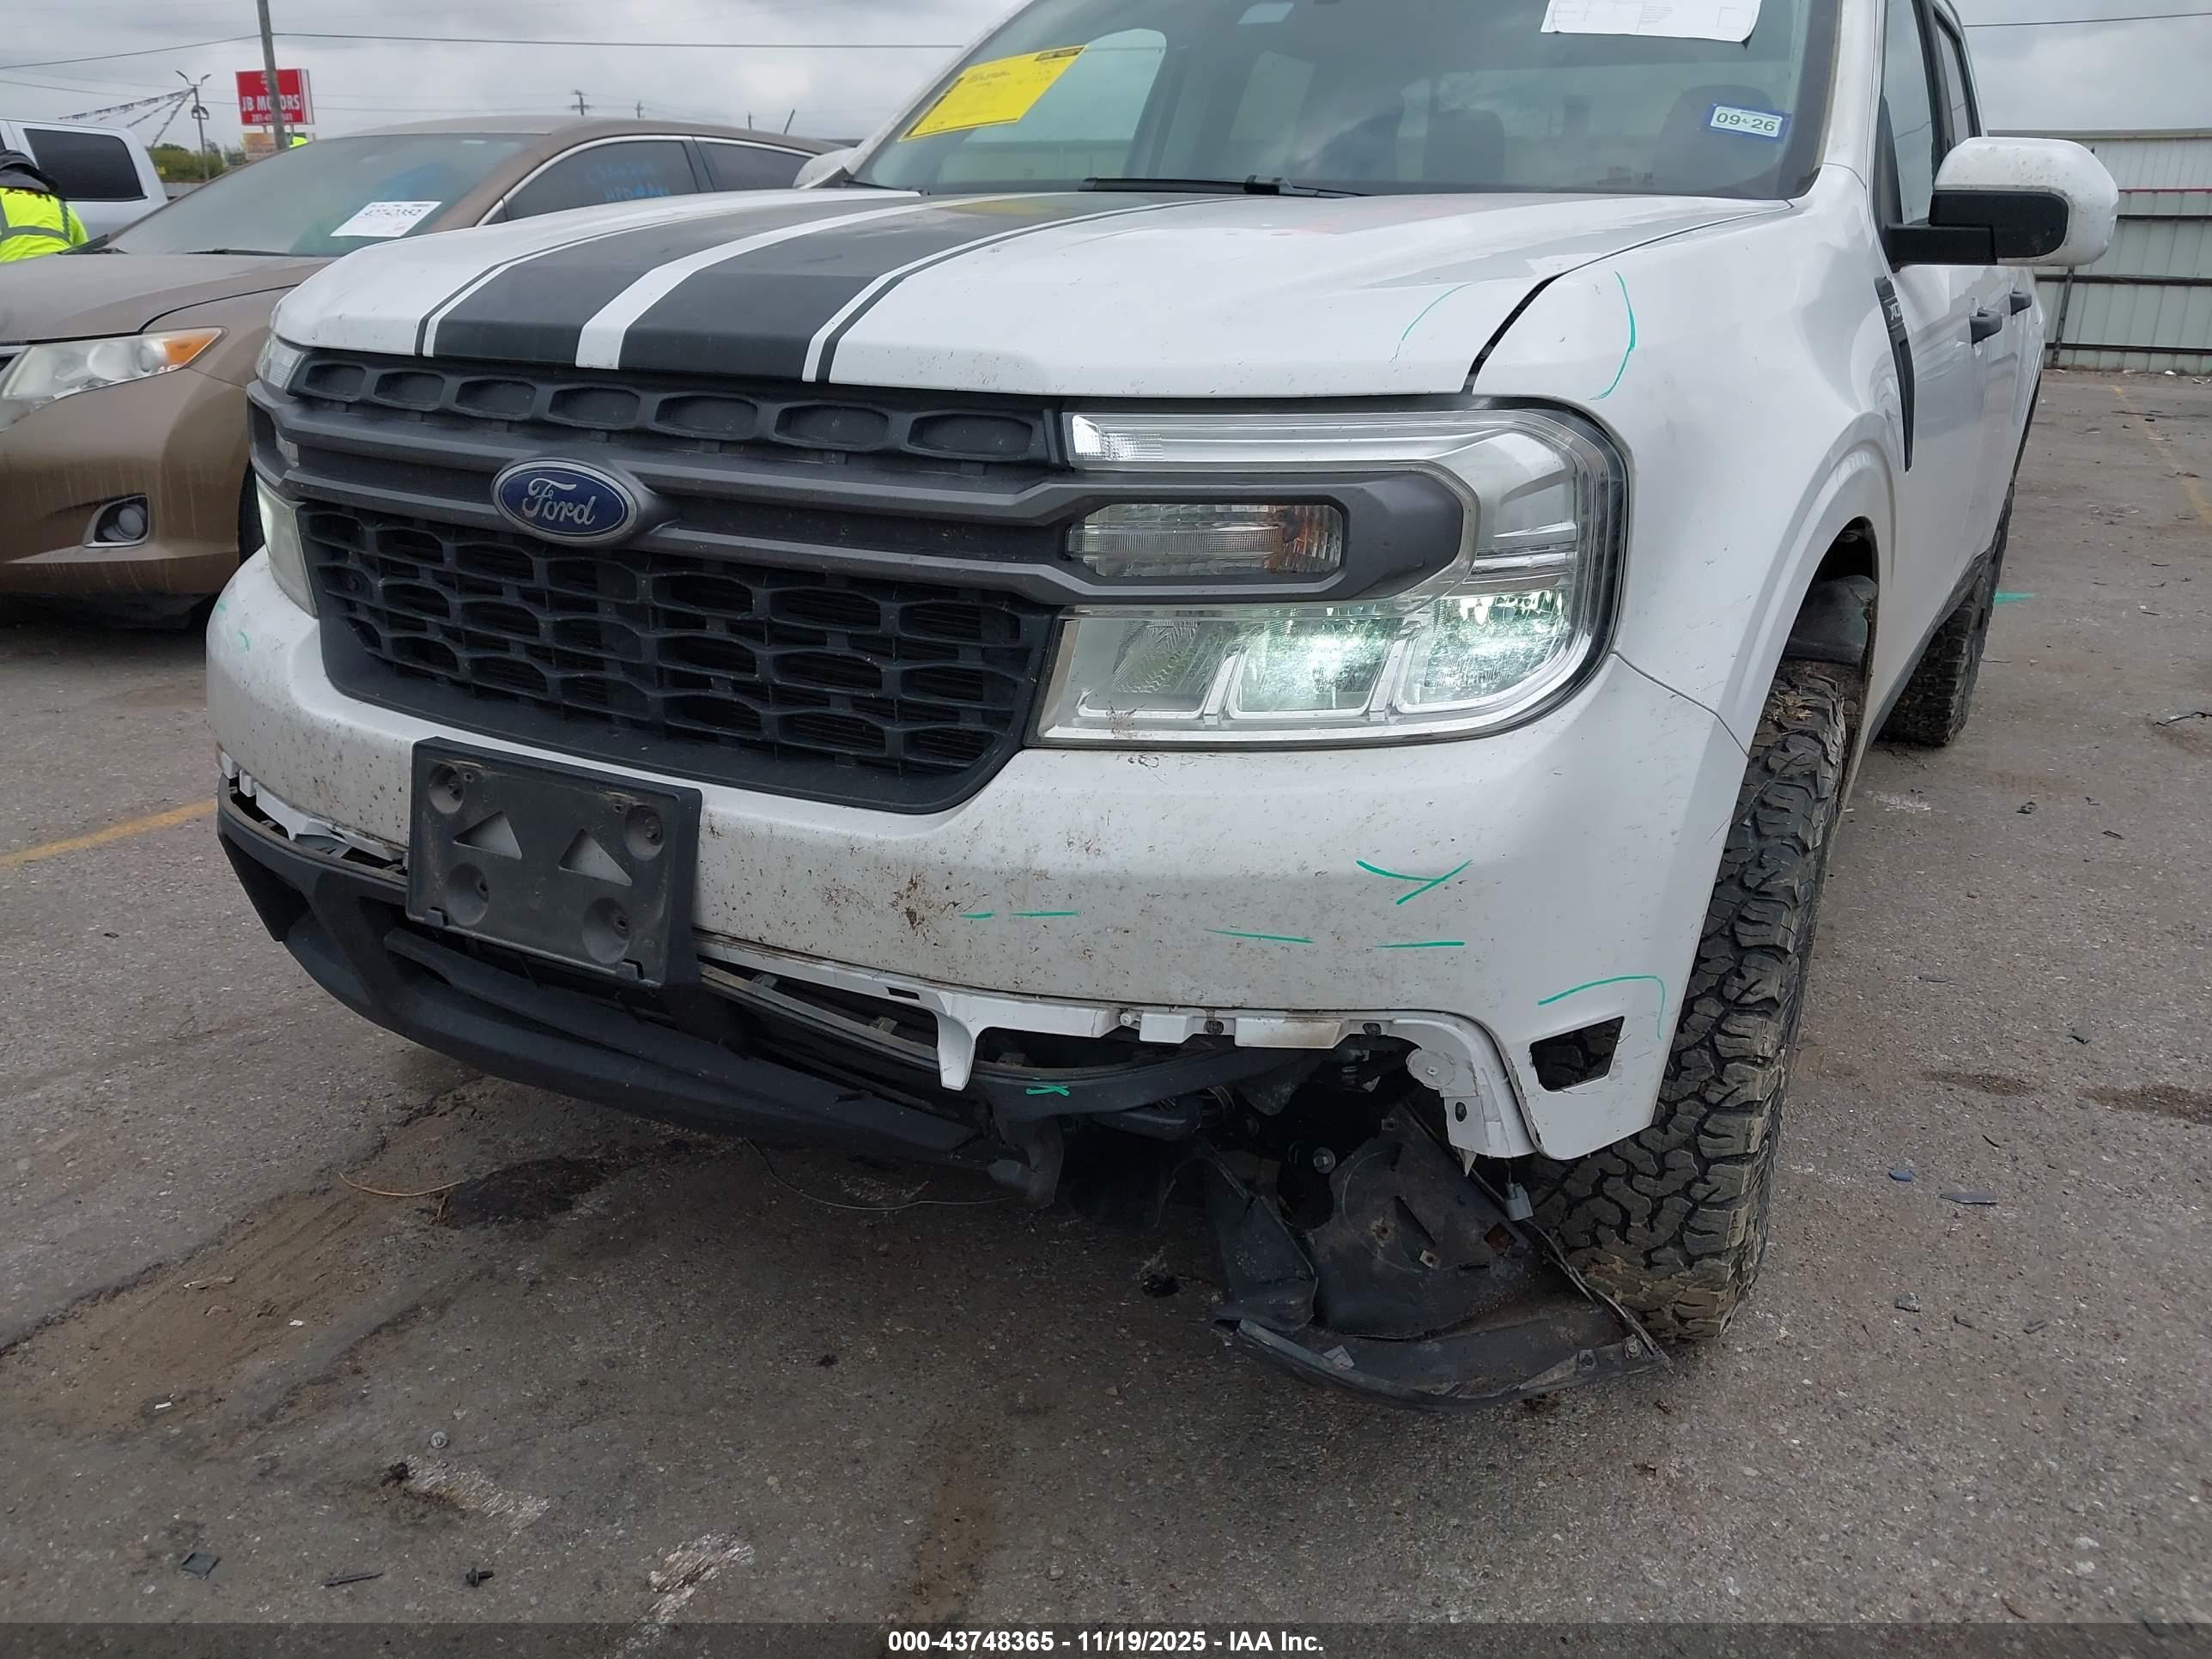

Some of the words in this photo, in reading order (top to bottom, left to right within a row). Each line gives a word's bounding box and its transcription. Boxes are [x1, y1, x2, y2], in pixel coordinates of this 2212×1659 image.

[242, 96, 254, 112] JB
[257, 94, 301, 111] MOORS
[1717, 112, 1741, 125] 09
[1751, 118, 1777, 131] 26
[521, 477, 597, 526] Ford
